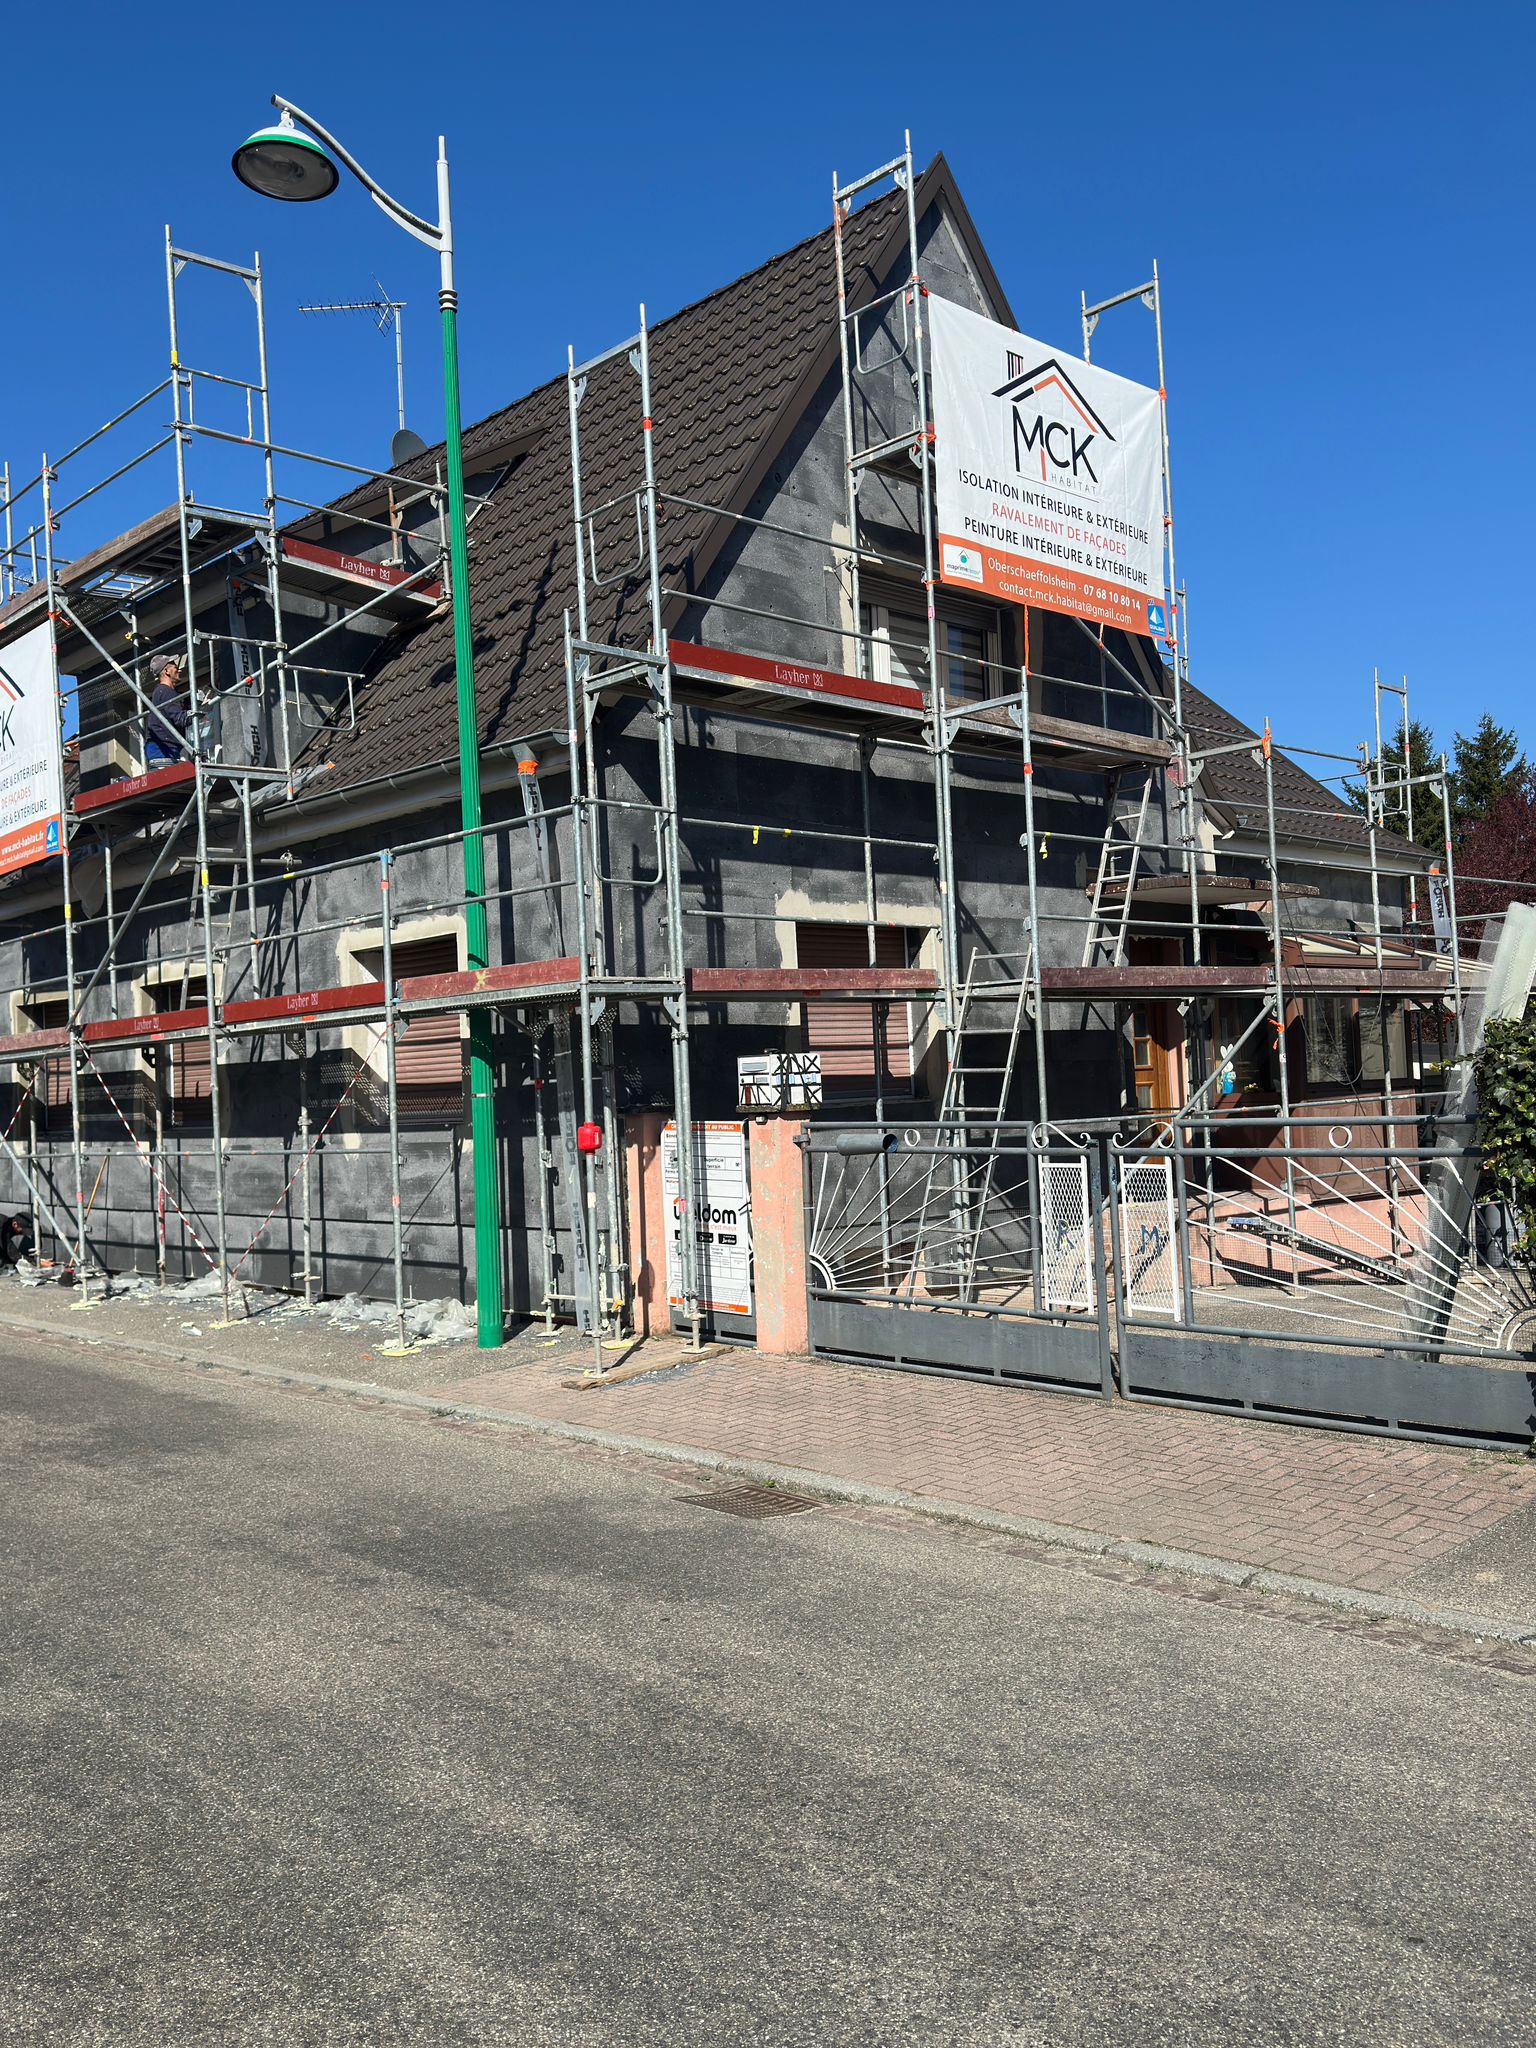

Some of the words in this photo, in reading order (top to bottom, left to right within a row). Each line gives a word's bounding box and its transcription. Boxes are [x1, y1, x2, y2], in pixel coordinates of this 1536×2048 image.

[1012, 405, 1098, 482] MCK
[1051, 473, 1097, 495] HABITAT
[959, 468, 1019, 500] ISOLATION
[1022, 490, 1083, 521] INTÉRIEURE
[1086, 511, 1094, 524] &
[1096, 514, 1149, 544] EXTÉRIEURE
[992, 502, 1064, 536] RAVALEMENT
[1067, 526, 1081, 541] DE
[1083, 531, 1127, 556] FAÇADES
[339, 556, 377, 577] Layher
[964, 517, 1019, 545] PEINTURE
[1022, 535, 1083, 564] INTÉRIEURE
[1085, 554, 1093, 567] &
[1095, 557, 1148, 586] EXTÉRIEURE
[987, 557, 1076, 592] Oberschaeffolsheim
[1083, 584, 1094, 597] 07
[1096, 588, 1107, 600] 68
[1109, 591, 1119, 603] 10
[1120, 595, 1130, 607] 80
[1131, 599, 1141, 611] 14
[999, 580, 1132, 624] contact.mck.habitat@gmail.com
[775, 665, 810, 684] Layher
[122, 779, 140, 793] Layher
[287, 995, 310, 1011] Layher
[134, 1018, 152, 1032] Layher
[1141, 1224, 1162, 1257] M
